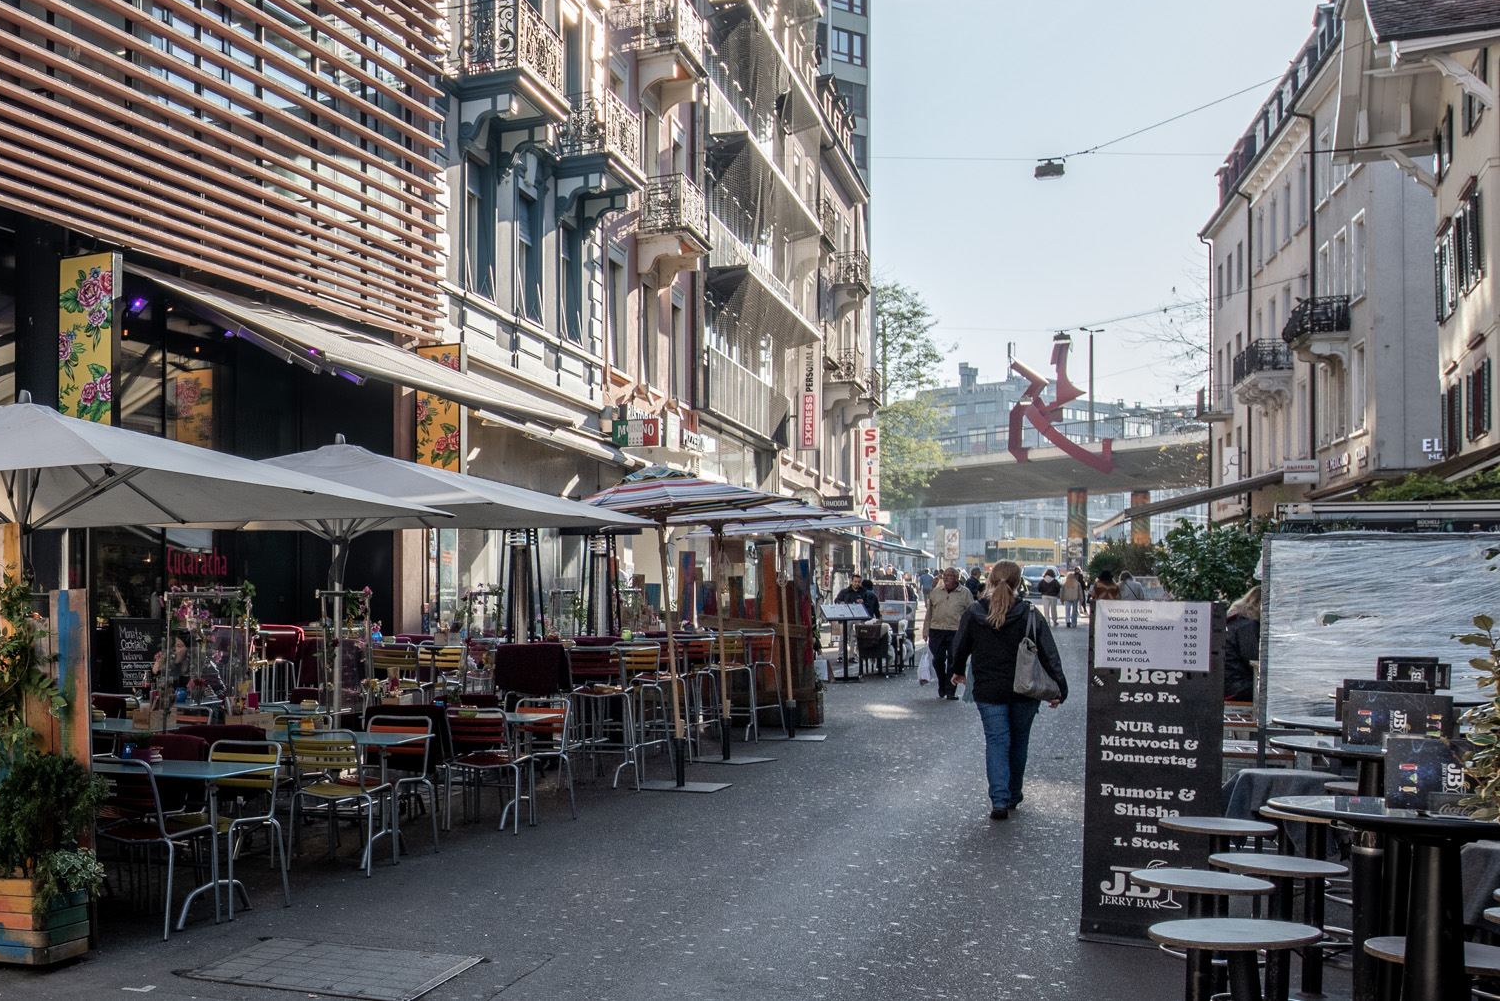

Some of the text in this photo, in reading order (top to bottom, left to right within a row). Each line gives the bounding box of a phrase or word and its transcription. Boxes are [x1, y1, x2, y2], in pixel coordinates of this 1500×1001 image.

[805, 351, 814, 392] PERSONAL
[804, 396, 813, 446] EXPRESS
[617, 423, 655, 438] MOLINO
[1422, 438, 1443, 452] EL
[167, 546, 228, 576] Cucaracha
[1118, 667, 1183, 685] Bier
[1119, 692, 1180, 703] 5.50 Fr.
[1115, 720, 1184, 734] NUR am
[1100, 735, 1199, 750] Mittwoch &
[1101, 750, 1197, 769] Donnerstag
[1100, 783, 1196, 802] Fumoir &
[1114, 802, 1180, 818] Shisha
[1135, 822, 1158, 833] im
[1113, 837, 1180, 851] 1. Stock
[1099, 895, 1160, 909] JERRY BAR
